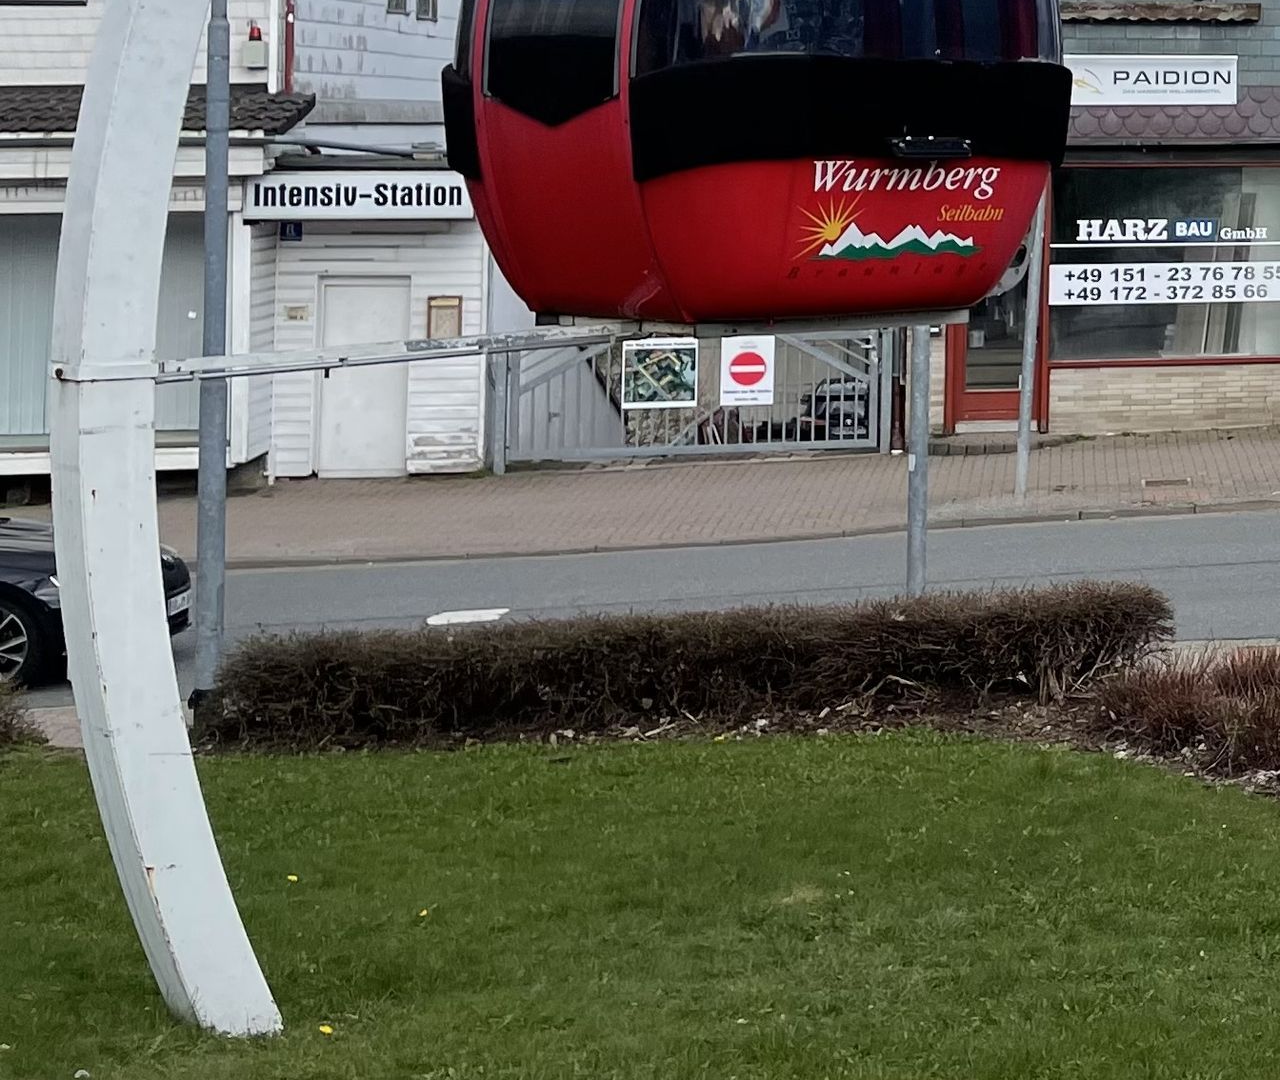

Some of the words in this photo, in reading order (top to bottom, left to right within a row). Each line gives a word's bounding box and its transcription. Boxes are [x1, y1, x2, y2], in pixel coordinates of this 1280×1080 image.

[1113, 70, 1232, 85] PAIDION
[813, 160, 1001, 200] Wurmberg
[254, 183, 462, 207] Intensiv-Station
[937, 204, 1005, 222] Seilbahn
[1076, 219, 1168, 241] HARZ
[1175, 221, 1213, 237] BAU
[1220, 227, 1268, 240] GmbH
[1064, 268, 1102, 283] +49
[1110, 267, 1146, 282] 151
[1167, 267, 1192, 282] 23
[1199, 266, 1224, 281] 76
[1231, 266, 1256, 281] 78
[1064, 286, 1102, 301] +49
[1109, 286, 1147, 301] 172
[1166, 285, 1204, 300] 372
[1211, 285, 1237, 299] 85
[1243, 284, 1268, 299] 66
